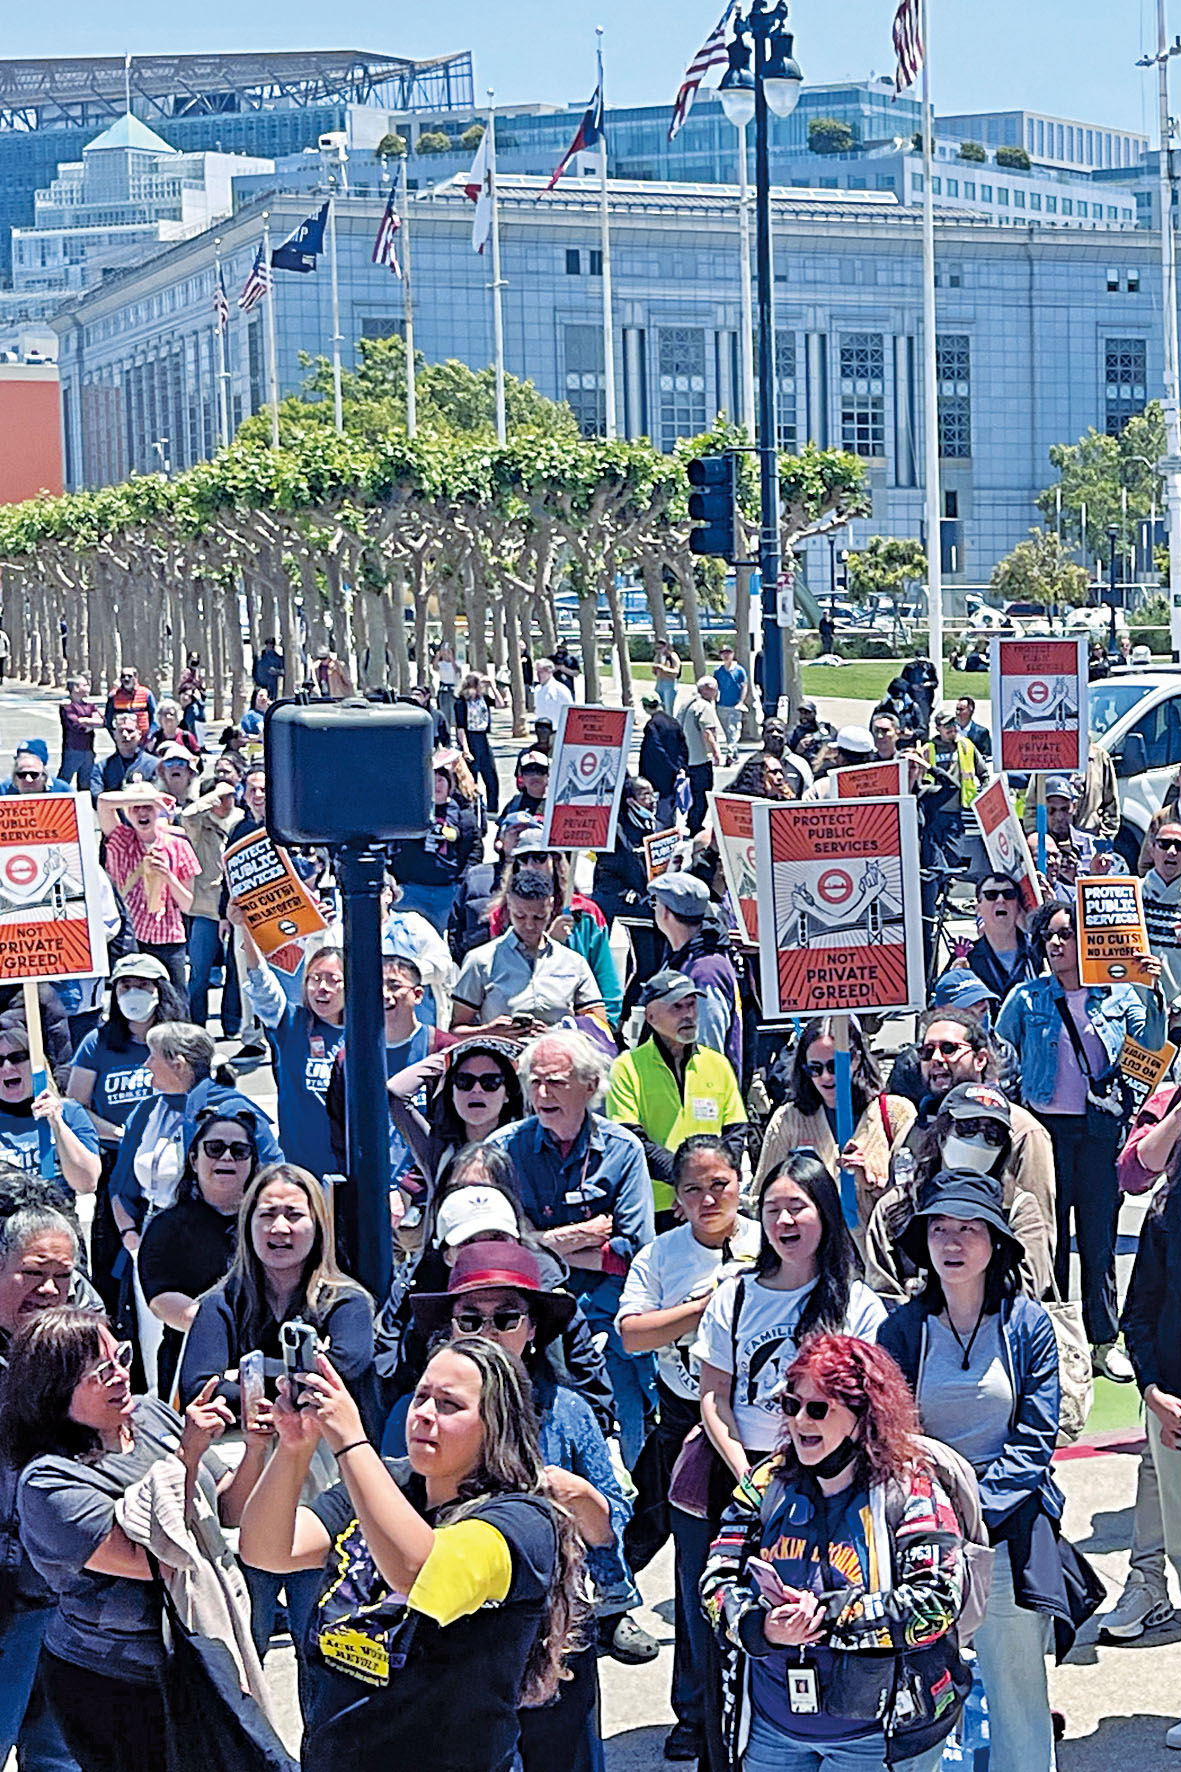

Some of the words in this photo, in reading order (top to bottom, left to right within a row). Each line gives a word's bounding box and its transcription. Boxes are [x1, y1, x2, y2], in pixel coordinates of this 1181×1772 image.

[793, 814, 854, 827] PROTECT
[1, 829, 59, 842] SERVICES
[808, 827, 855, 840] PUBLIC
[814, 840, 878, 853] SERVICES
[1085, 886, 1134, 899] PROTECT
[1086, 899, 1136, 913] PUBLIC
[1086, 913, 1139, 925] SERVICES
[17, 927, 44, 938] NOT
[1087, 935, 1104, 945] NO
[1108, 934, 1142, 945] CUTS!
[827, 953, 856, 965] NOT
[1088, 948, 1101, 957] NO
[4, 953, 62, 970] GREED!
[807, 966, 878, 982] PRIVATE
[811, 984, 875, 999] GREED!
